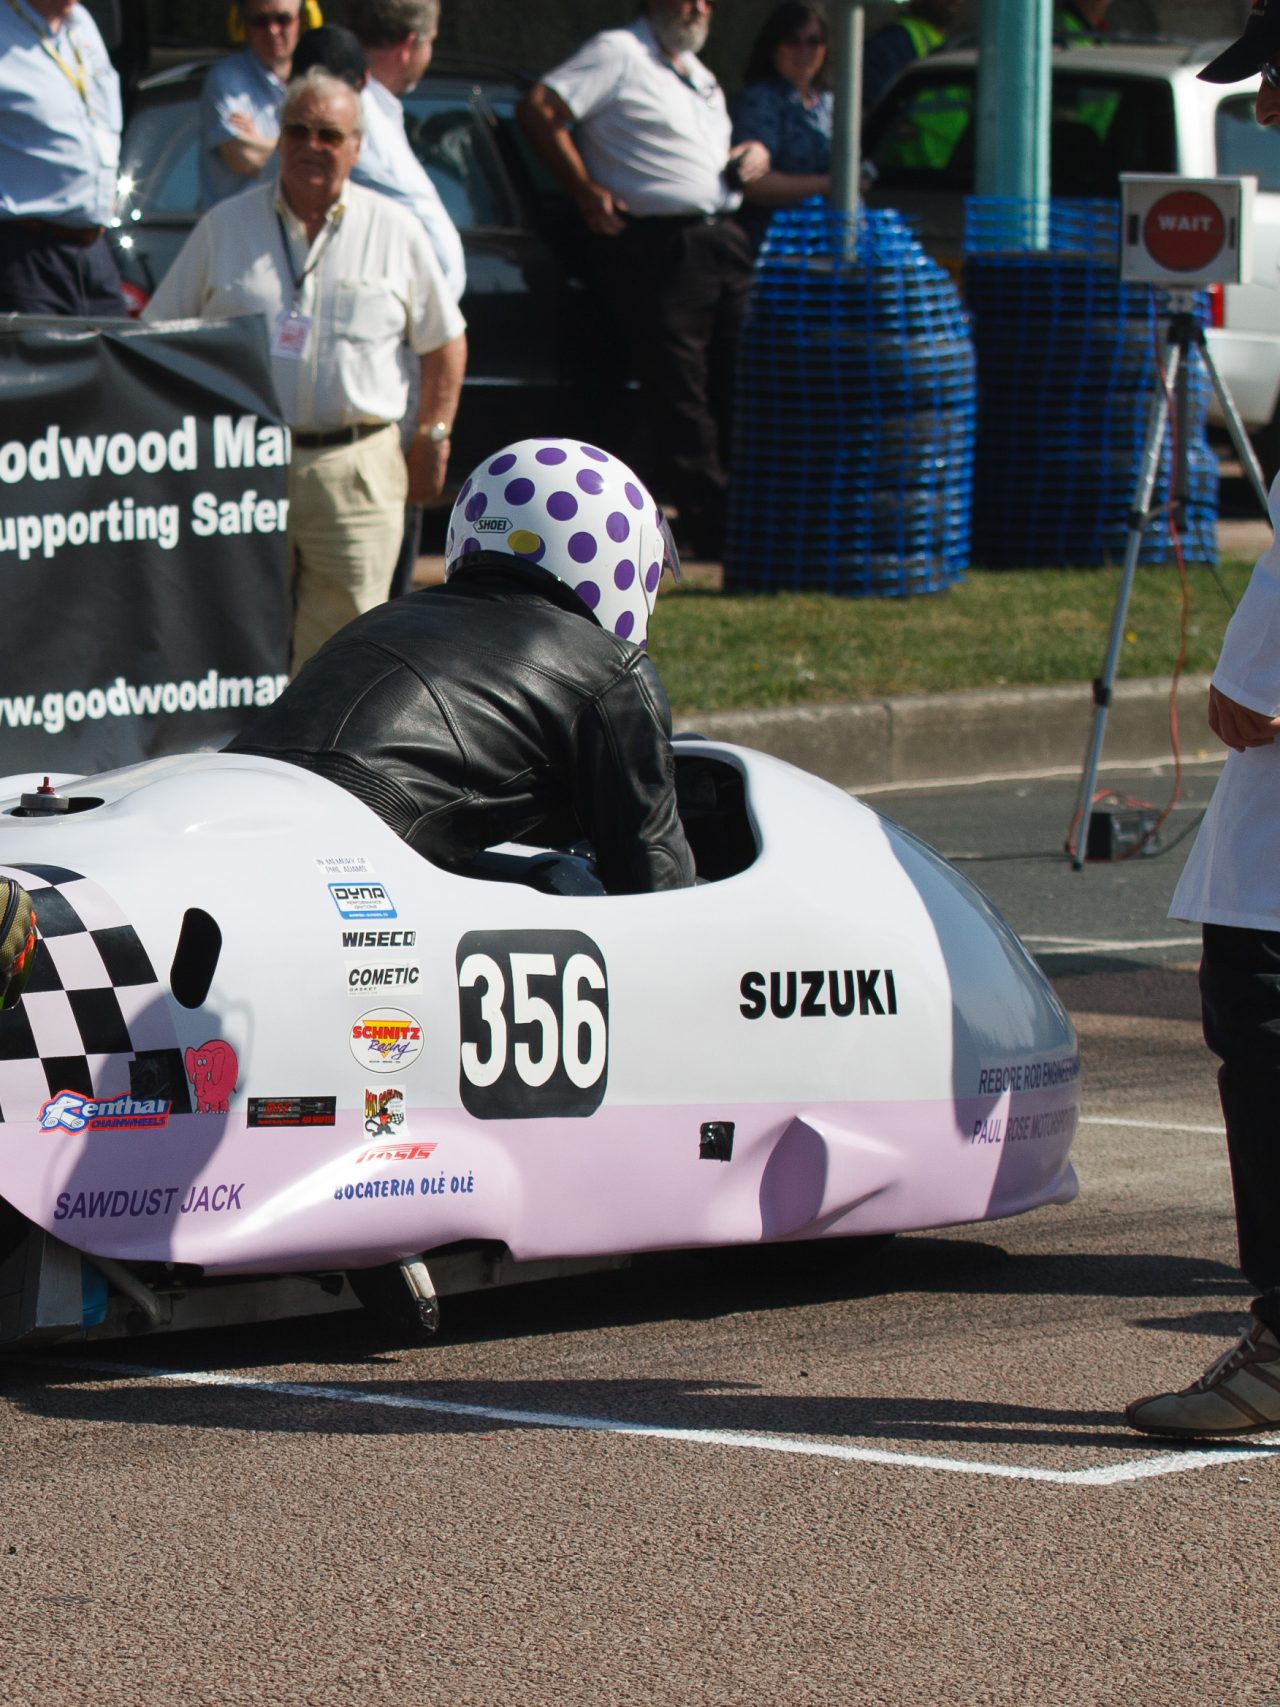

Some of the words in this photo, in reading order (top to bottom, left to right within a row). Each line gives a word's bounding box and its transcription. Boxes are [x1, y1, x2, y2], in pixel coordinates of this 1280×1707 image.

[1158, 215, 1212, 231] WAIT
[191, 490, 290, 536] Safer
[477, 519, 507, 531] SHOEI
[334, 887, 386, 900] DYNA
[342, 931, 417, 948] WISECO
[348, 967, 420, 986] COMETIC
[739, 969, 898, 1020] SUZUKI
[459, 952, 607, 1089] 356
[352, 1025, 421, 1040] SCHNITZ
[368, 1039, 418, 1060] Racing
[978, 1066, 1023, 1095] REBORE
[1024, 1064, 1042, 1090] ROD
[972, 1118, 1003, 1145] PAUL
[334, 1178, 416, 1201] BOCATERIA
[53, 1187, 179, 1220] SAWDUST
[180, 1183, 246, 1213] JACK
